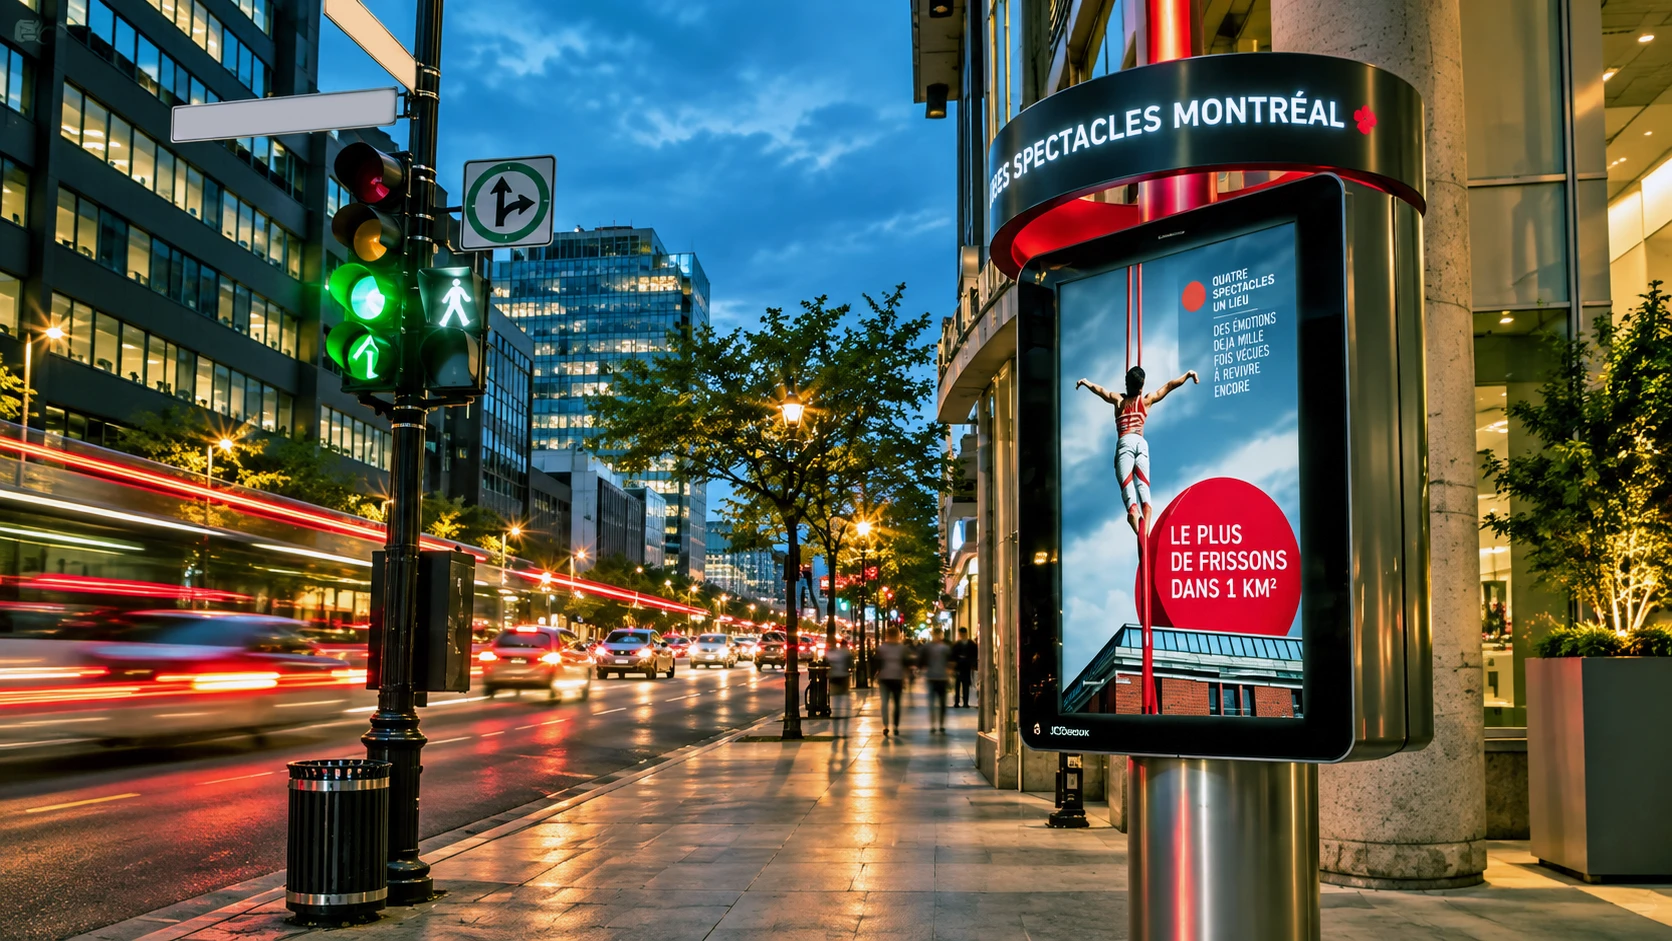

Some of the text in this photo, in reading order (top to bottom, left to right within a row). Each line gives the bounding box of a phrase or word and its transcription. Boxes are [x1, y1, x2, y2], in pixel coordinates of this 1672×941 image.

[1013, 105, 1161, 179] SPECTACLES
[1173, 90, 1345, 129] MONTRÉAL
[1212, 268, 1248, 286] QUATRE
[1212, 273, 1275, 299] SPECTACLES
[1213, 294, 1249, 312] UN LIEU
[1213, 312, 1276, 337] DES ÉMOTIONS
[1238, 329, 1263, 346] MILLE
[1214, 351, 1234, 367] FOIS
[1223, 361, 1261, 381] REVIVRE
[1214, 379, 1250, 398] ENCORE
[1170, 523, 1243, 545] LE PLUS
[1171, 549, 1288, 572] DE FRISSONS
[1171, 577, 1277, 599] DANS 1 KM²
